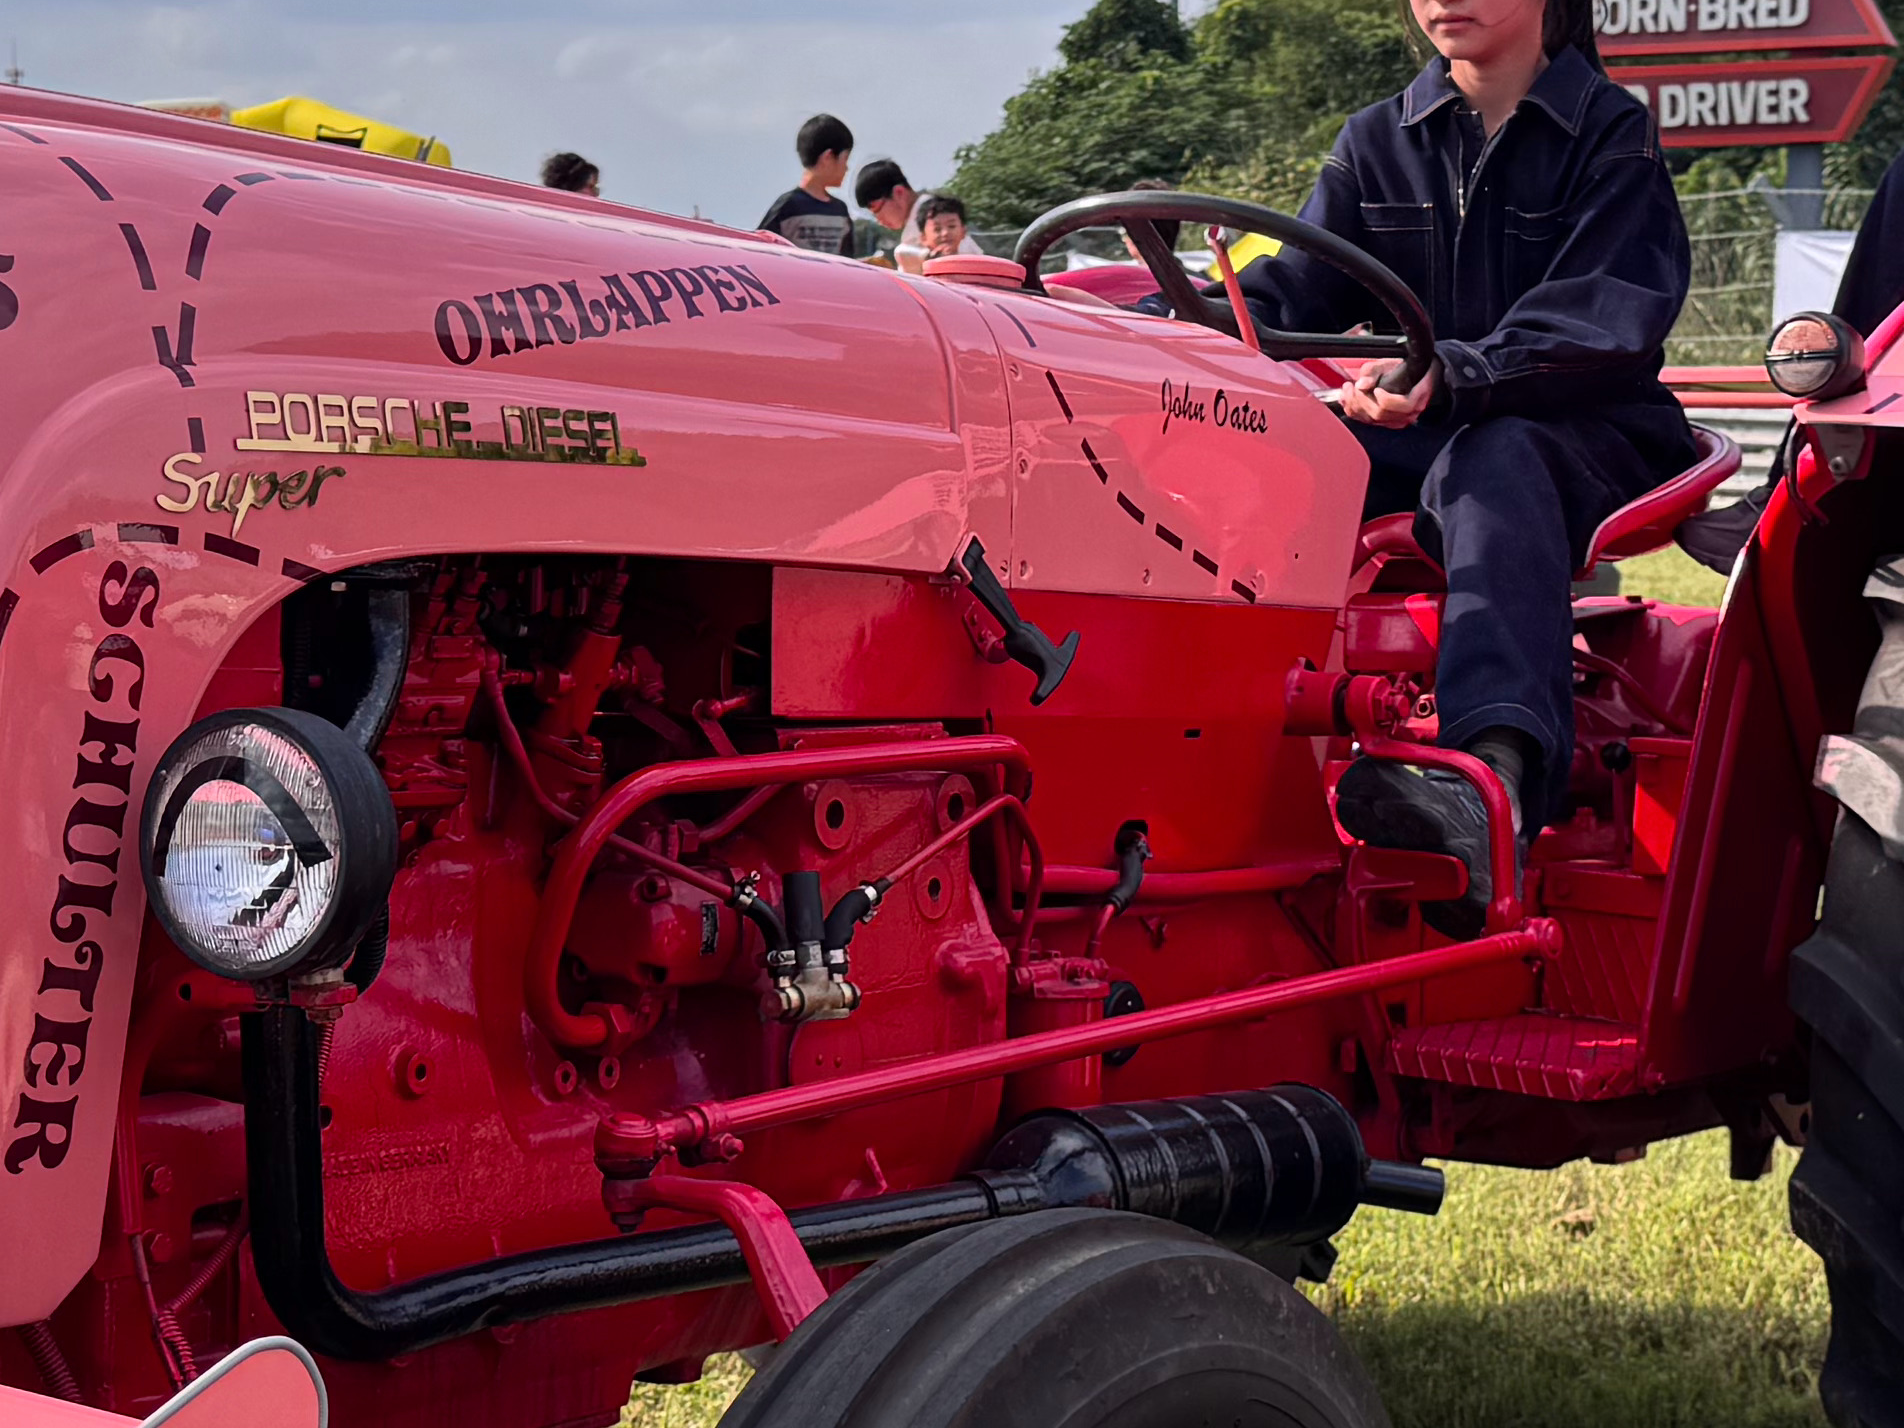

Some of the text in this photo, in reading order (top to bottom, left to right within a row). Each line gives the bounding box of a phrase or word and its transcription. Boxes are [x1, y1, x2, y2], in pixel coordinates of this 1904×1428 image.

[1659, 78, 1810, 129] DRIVER
[434, 264, 781, 366] OHRLAPPEN
[245, 390, 626, 457] PORSCHE DIESEL
[1161, 377, 1269, 435] John Oates
[156, 452, 346, 538] Super
